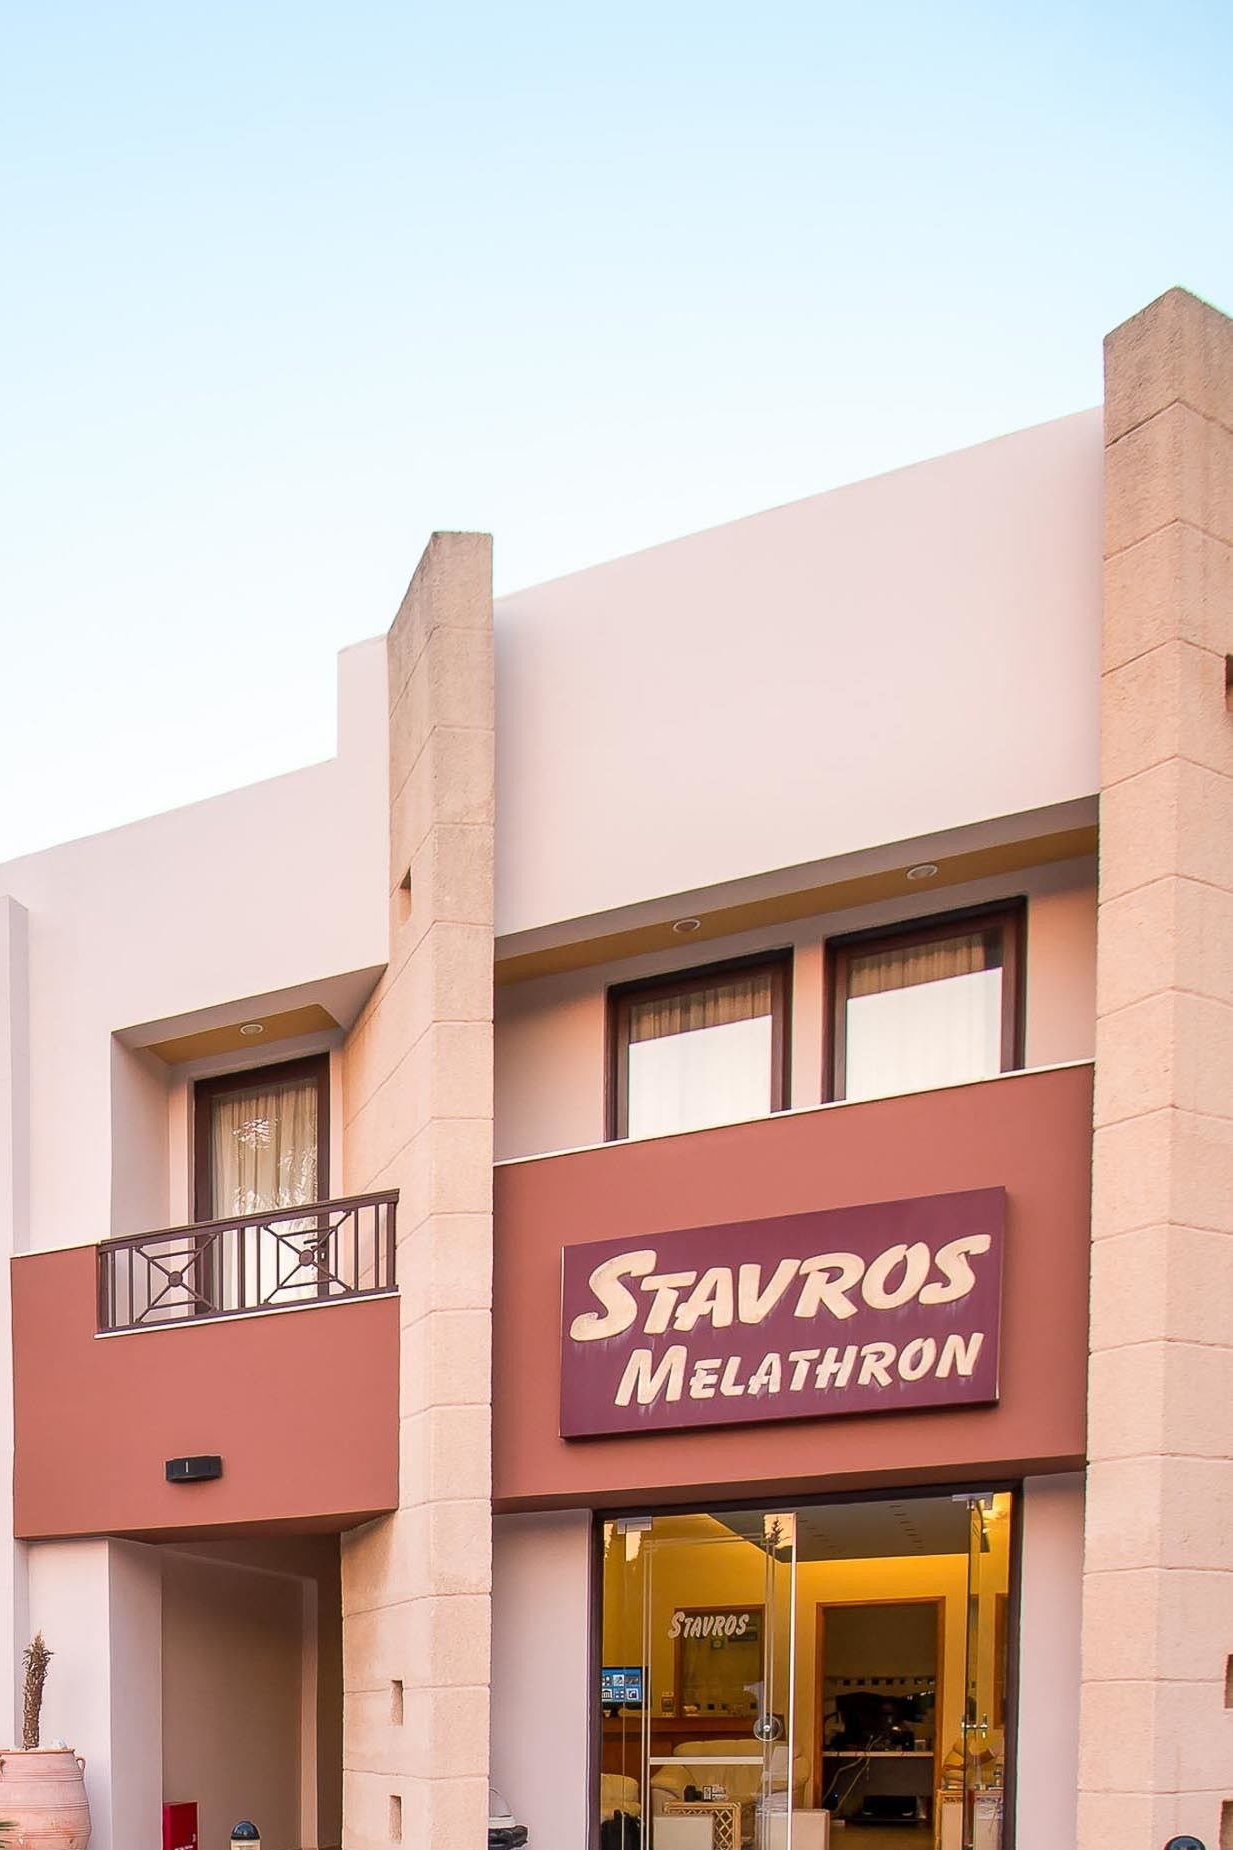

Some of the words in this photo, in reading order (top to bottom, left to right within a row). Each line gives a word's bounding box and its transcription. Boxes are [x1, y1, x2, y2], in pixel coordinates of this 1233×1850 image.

[569, 1233, 992, 1342] STAVROS
[614, 1332, 985, 1407] MELATHRON
[668, 1611, 750, 1639] STAVROS
